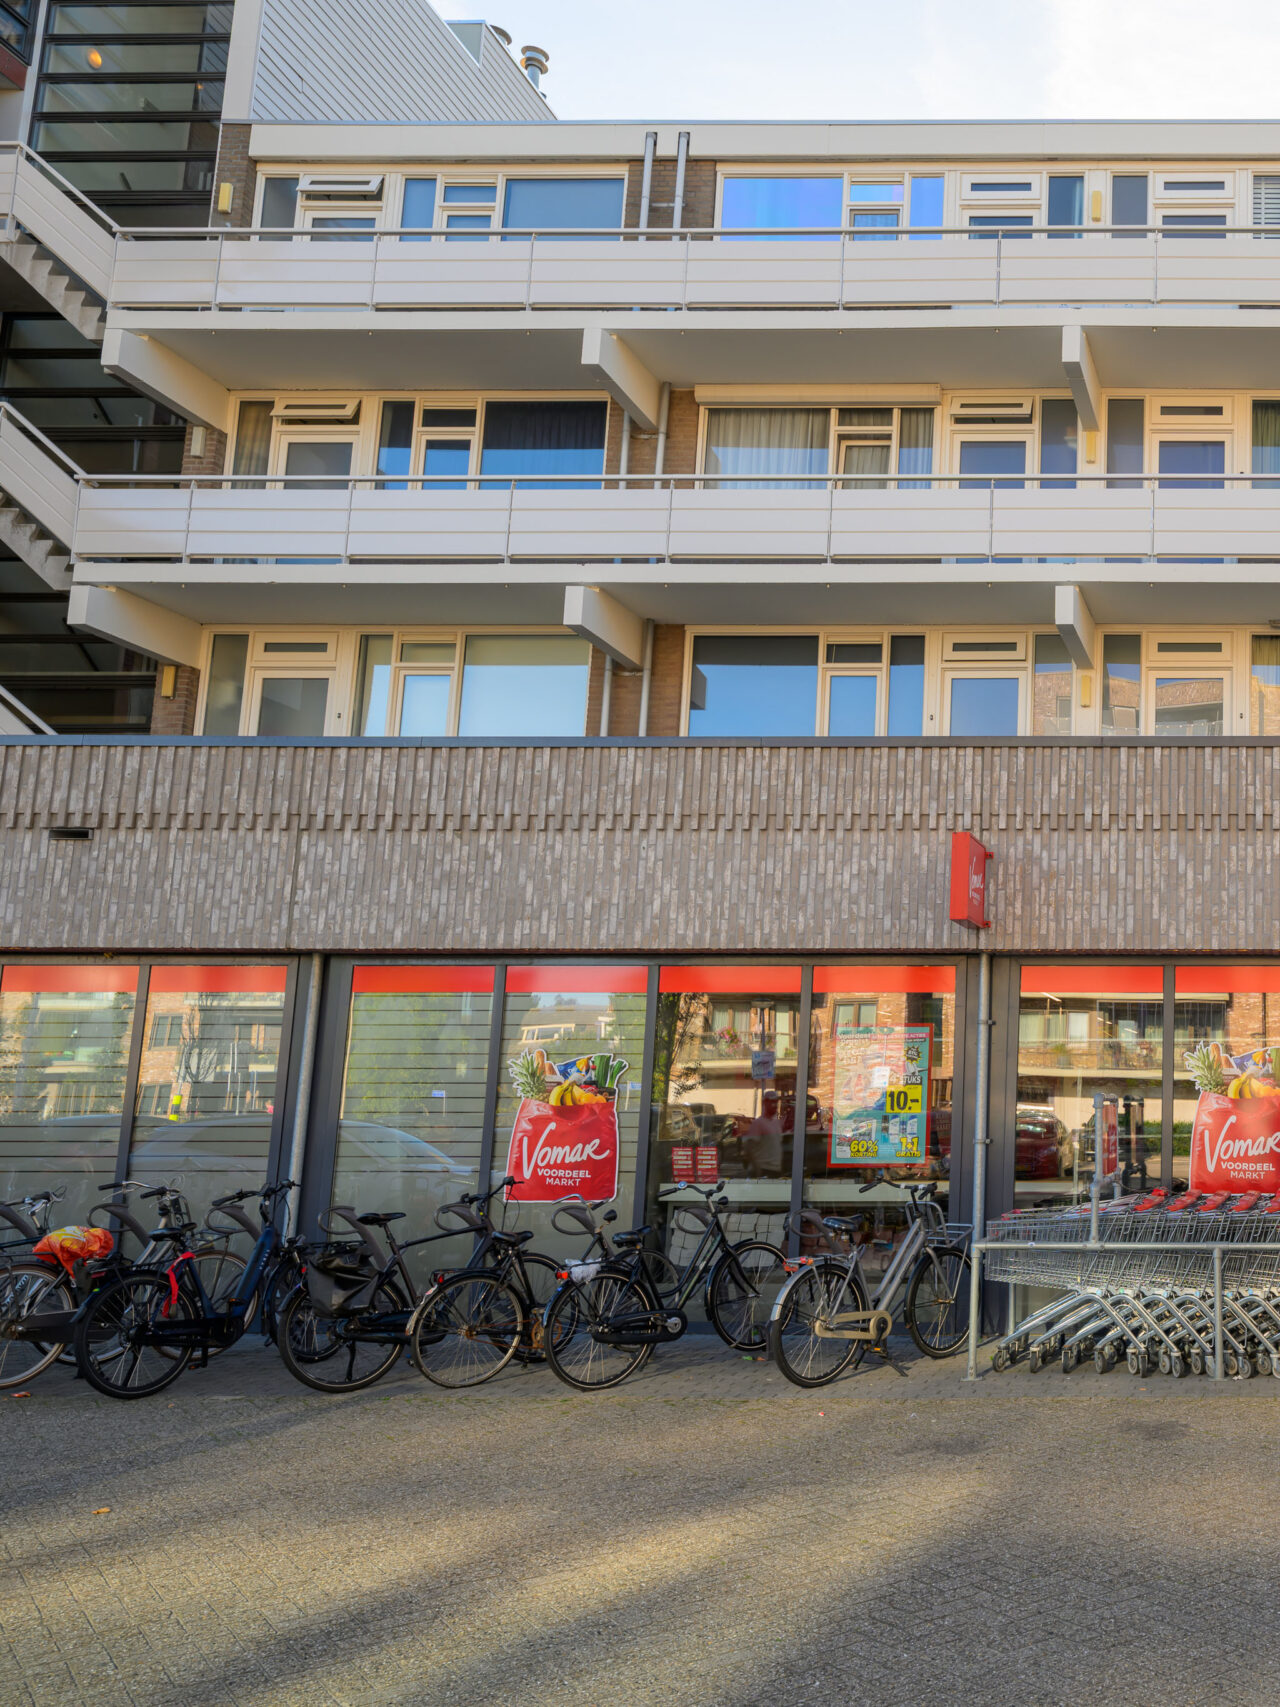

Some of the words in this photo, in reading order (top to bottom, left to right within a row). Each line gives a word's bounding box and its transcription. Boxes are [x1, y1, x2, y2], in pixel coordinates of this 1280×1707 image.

[850, 1139, 879, 1152] 60%
[900, 1136, 920, 1151] 1+1
[522, 1121, 610, 1179] Vomar
[1221, 1161, 1276, 1171] VOORDEEL
[537, 1168, 591, 1178] VOORDEEL
[1230, 1171, 1266, 1180] MARKT
[546, 1178, 581, 1187] MARKT
